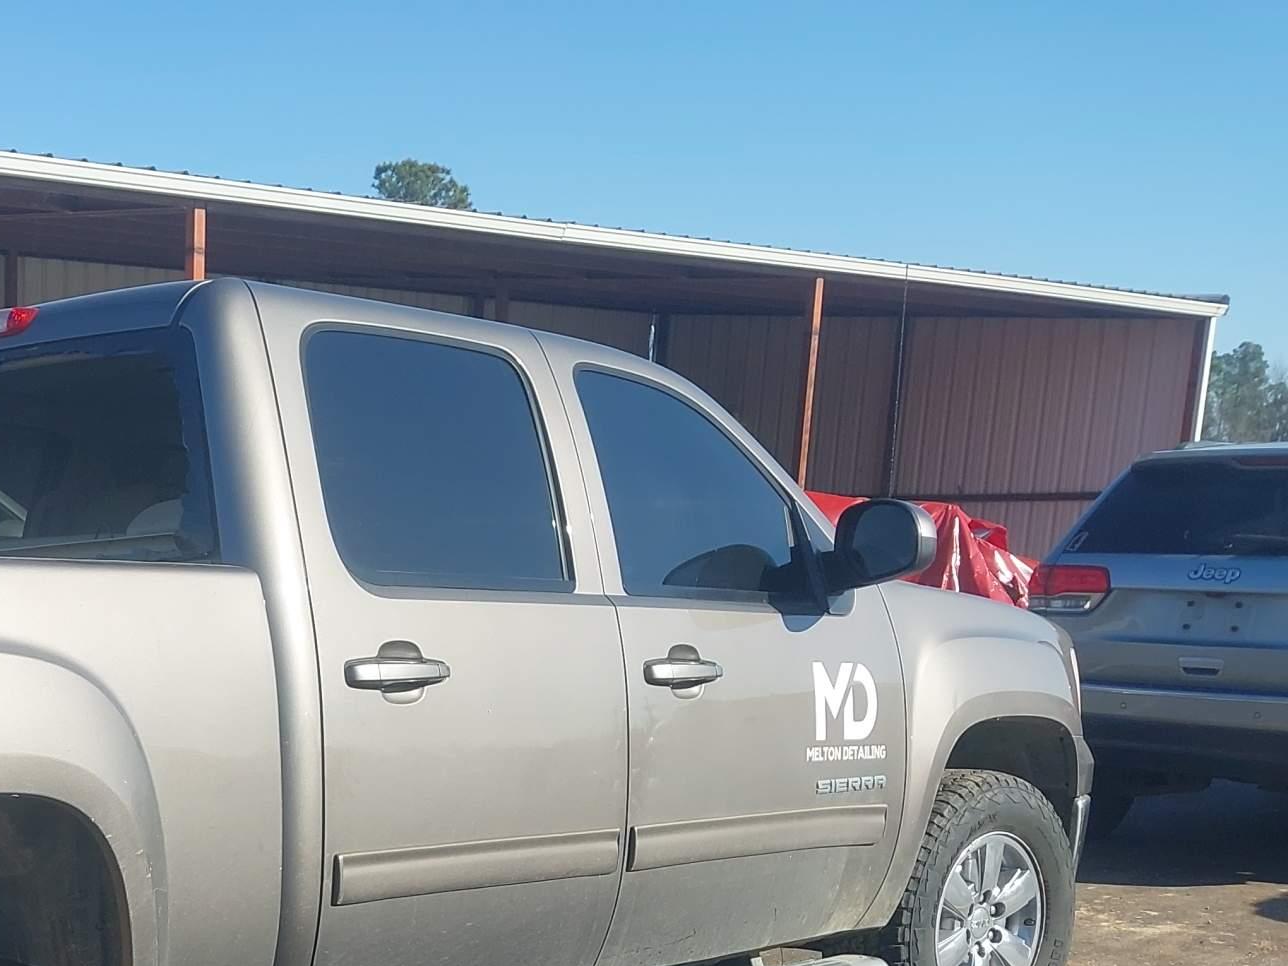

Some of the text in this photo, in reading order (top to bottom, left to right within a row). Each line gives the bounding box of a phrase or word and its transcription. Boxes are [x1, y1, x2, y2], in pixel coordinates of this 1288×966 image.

[1188, 564, 1241, 584] Jeep
[812, 661, 878, 741] MD
[806, 744, 887, 762] MELTON DETAILING
[815, 775, 887, 795] SIERRA
